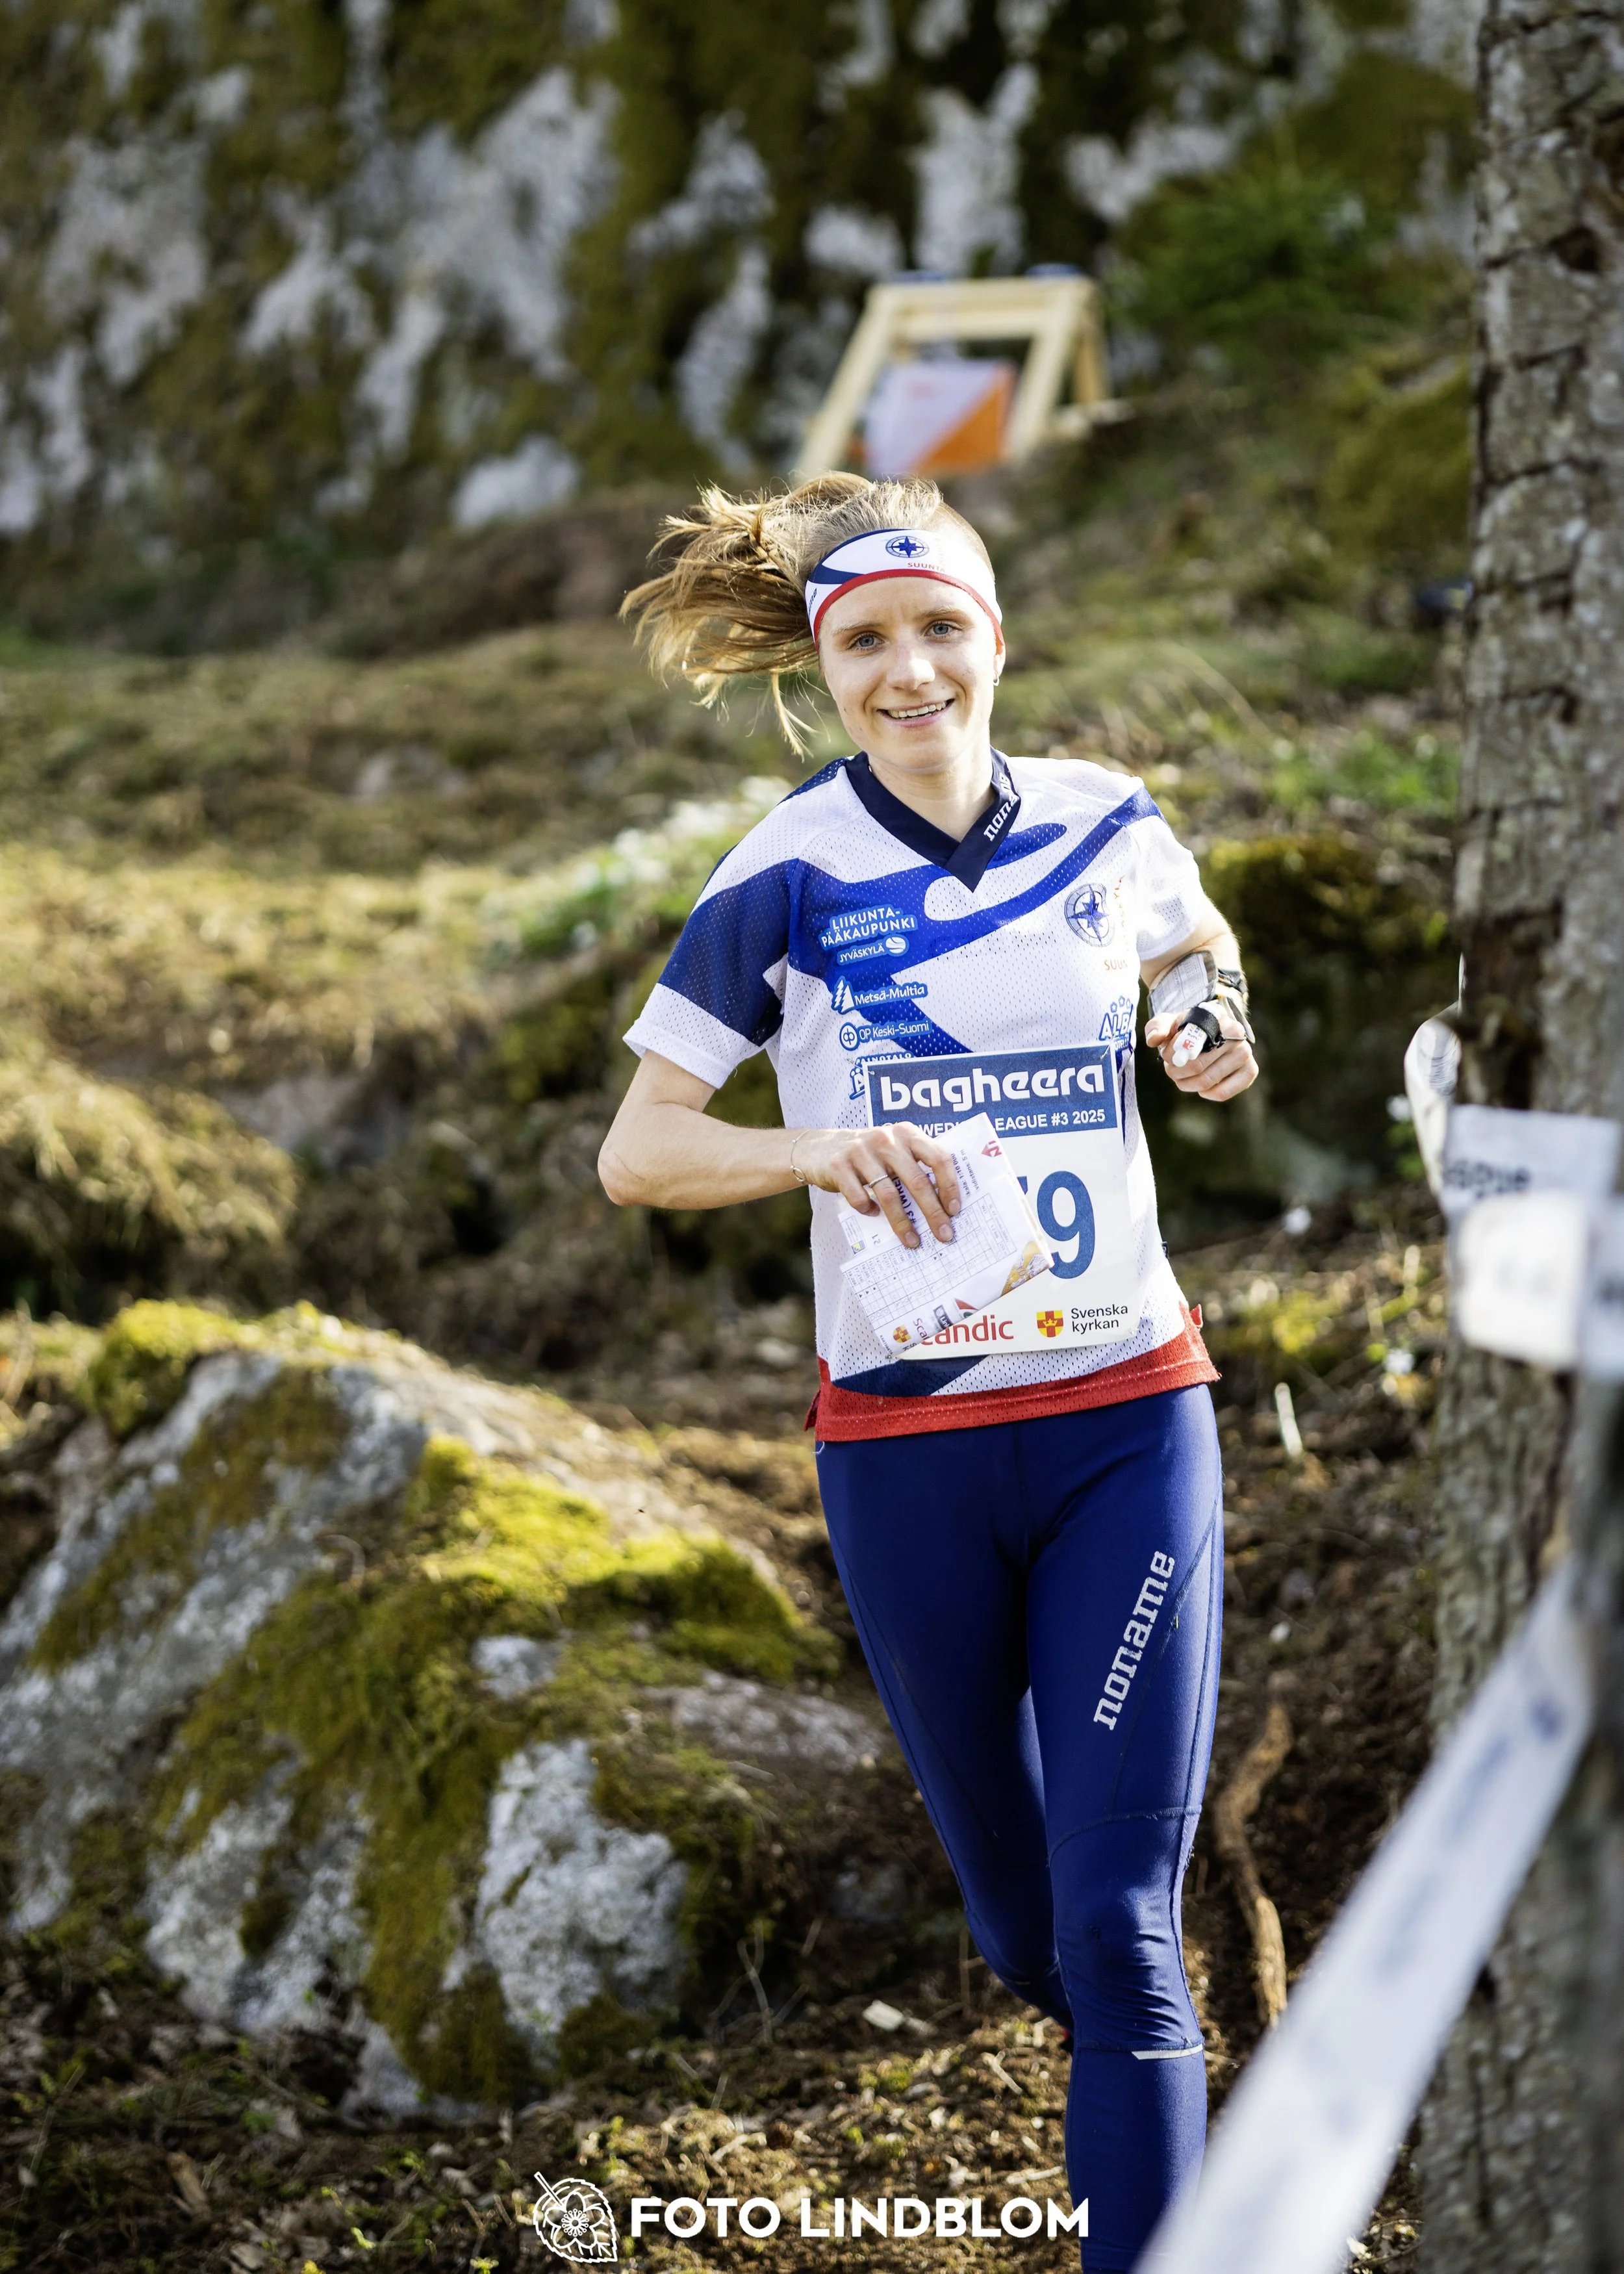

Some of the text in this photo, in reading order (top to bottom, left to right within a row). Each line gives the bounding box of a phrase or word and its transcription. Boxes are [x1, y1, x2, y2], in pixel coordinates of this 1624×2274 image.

[832, 907, 900, 930] LIIKUNTA-
[821, 917, 915, 947] PÄÄKAUPUNKI
[839, 943, 885, 963] JYVÄSKYLÄ
[854, 984, 925, 1006] Metsä-Multia
[859, 1021, 930, 1040] OP Keski-Suomi
[880, 1064, 1105, 1112] bagheera
[994, 1113, 1048, 1132] EAGUE
[1051, 1114, 1069, 1127] #3
[1073, 1109, 1106, 1124] 2025
[1017, 1170, 1096, 1279] 9
[1071, 1304, 1128, 1320] Svenska
[1072, 1320, 1119, 1335] kyrkan
[1093, 1550, 1175, 1731] noname
